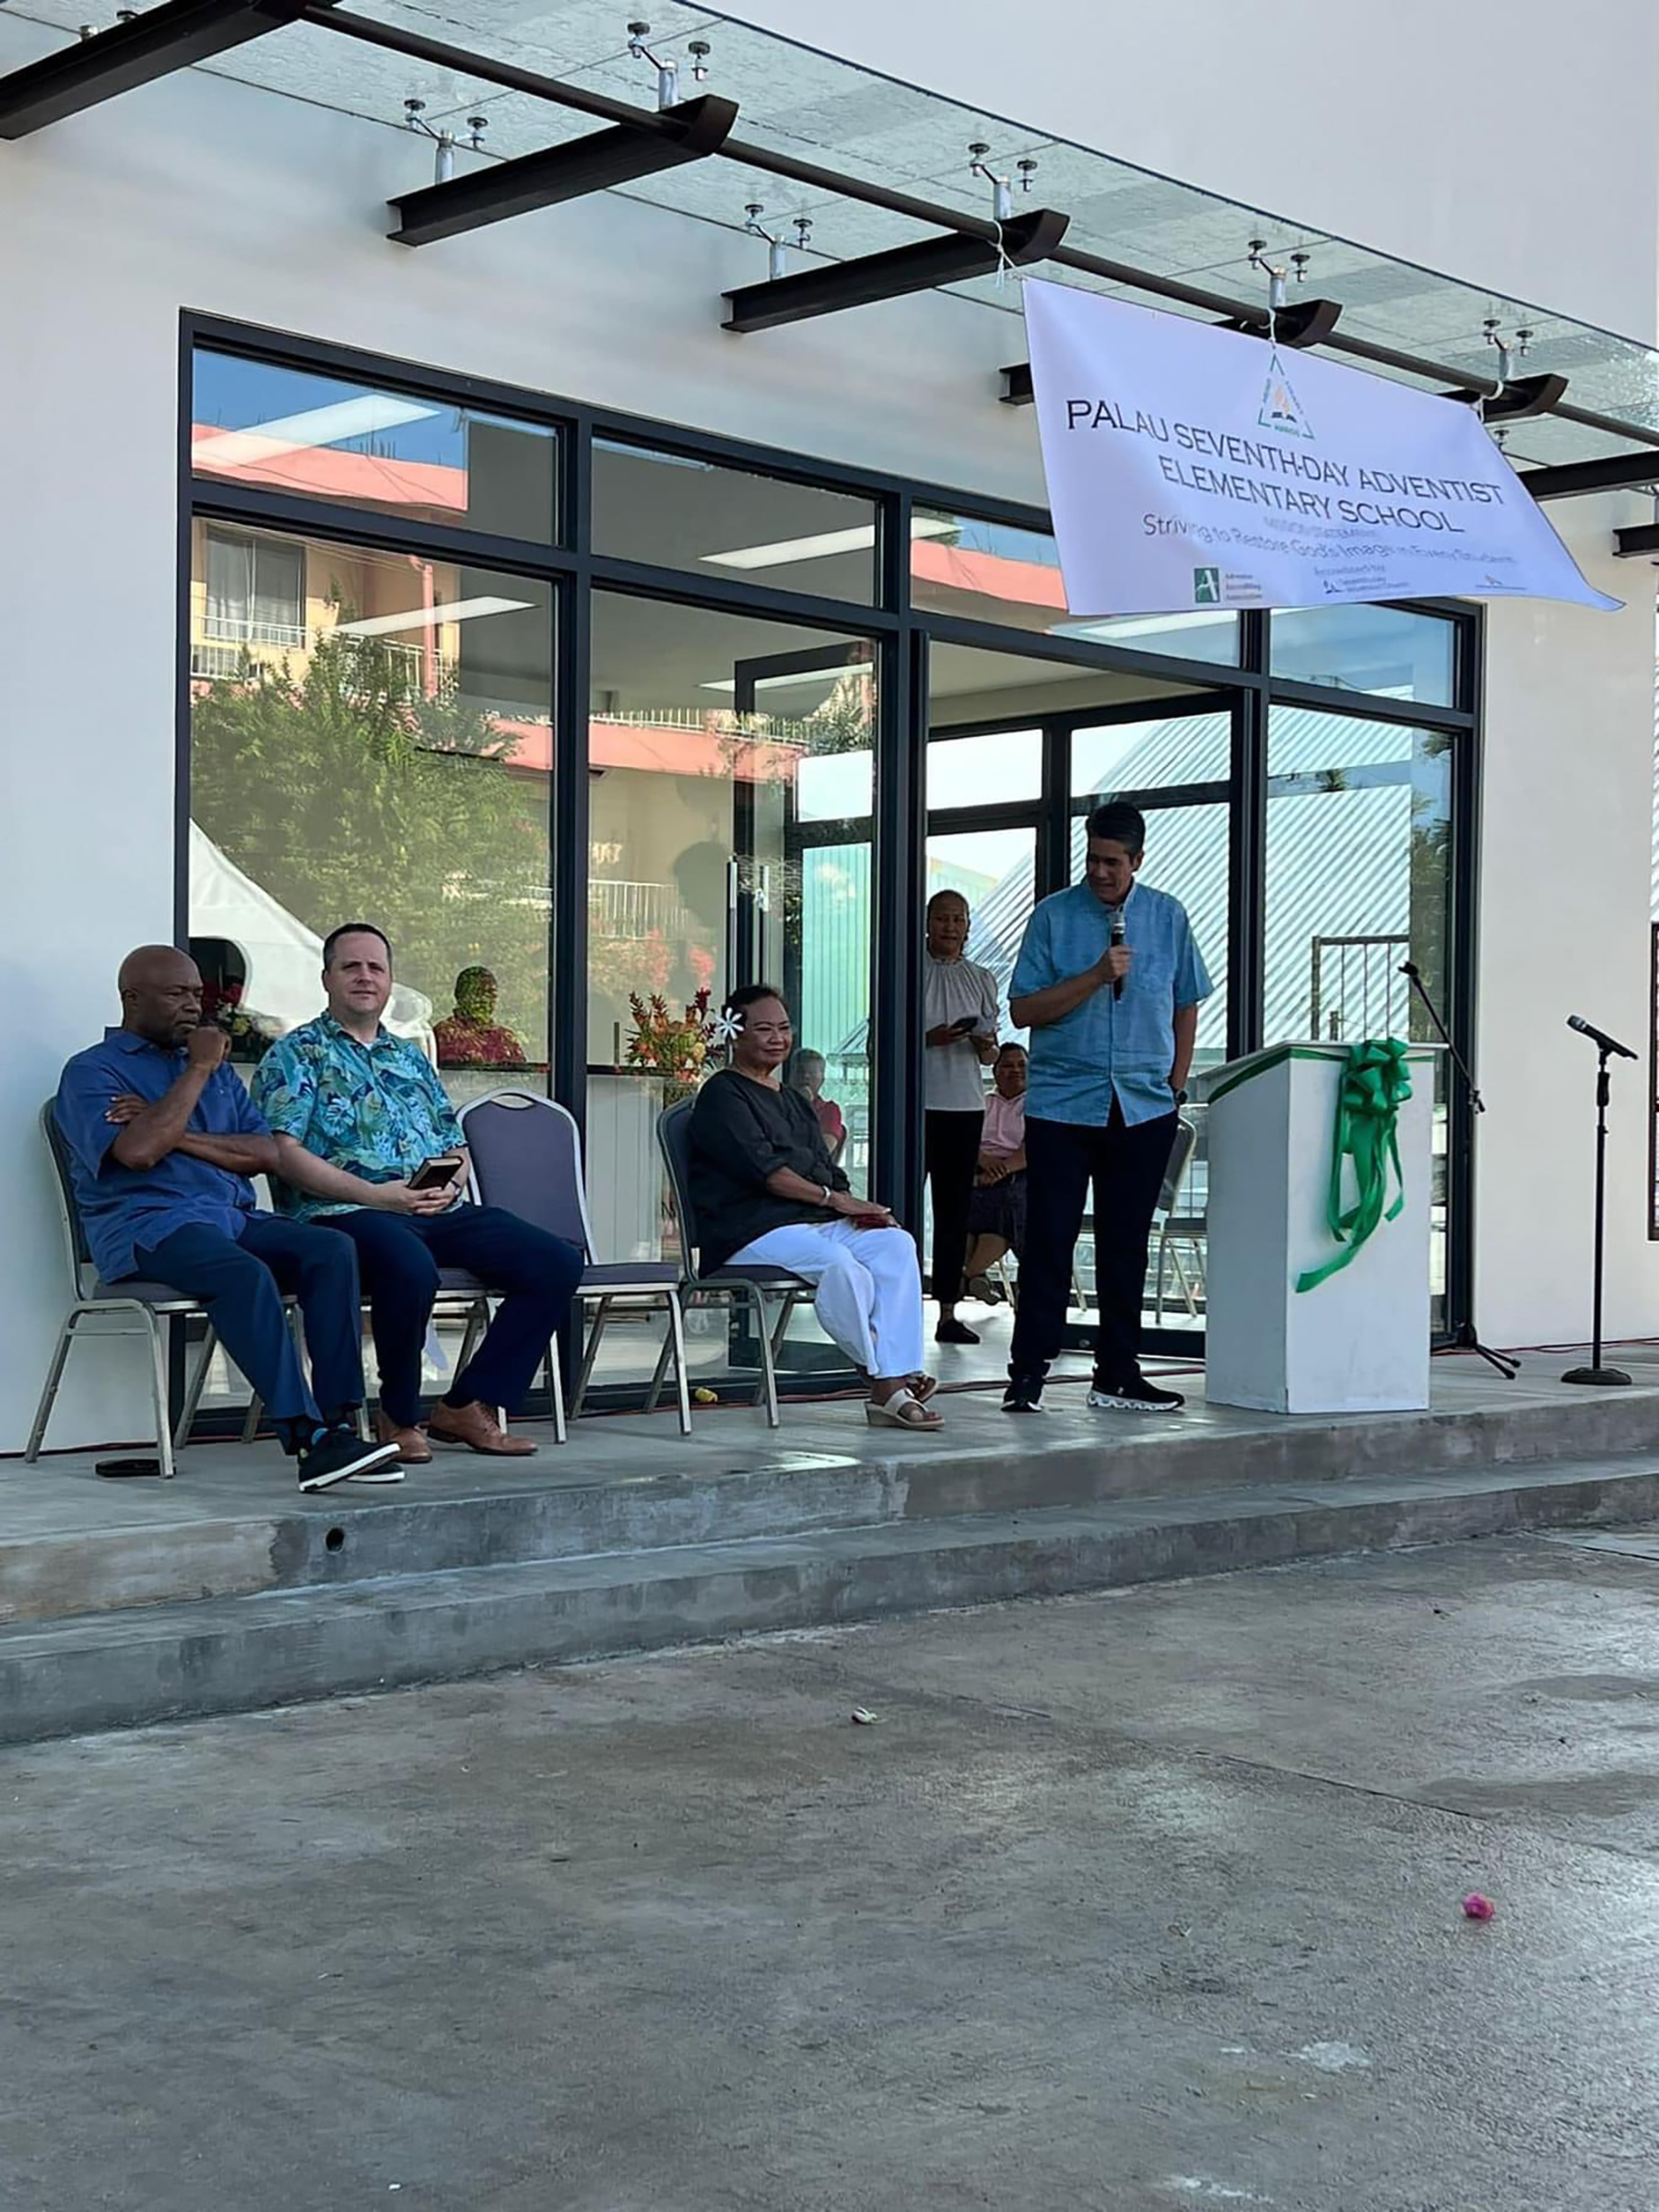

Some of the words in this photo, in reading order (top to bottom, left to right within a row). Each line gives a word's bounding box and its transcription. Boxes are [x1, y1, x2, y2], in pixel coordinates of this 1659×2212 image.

[1066, 399, 1170, 443] PALAU
[1172, 422, 1350, 488] SEVENTH-DAY
[1359, 468, 1505, 505] ADVENTIST
[1159, 454, 1332, 520] ELEMENTARY
[1337, 499, 1465, 534] SCHOOL
